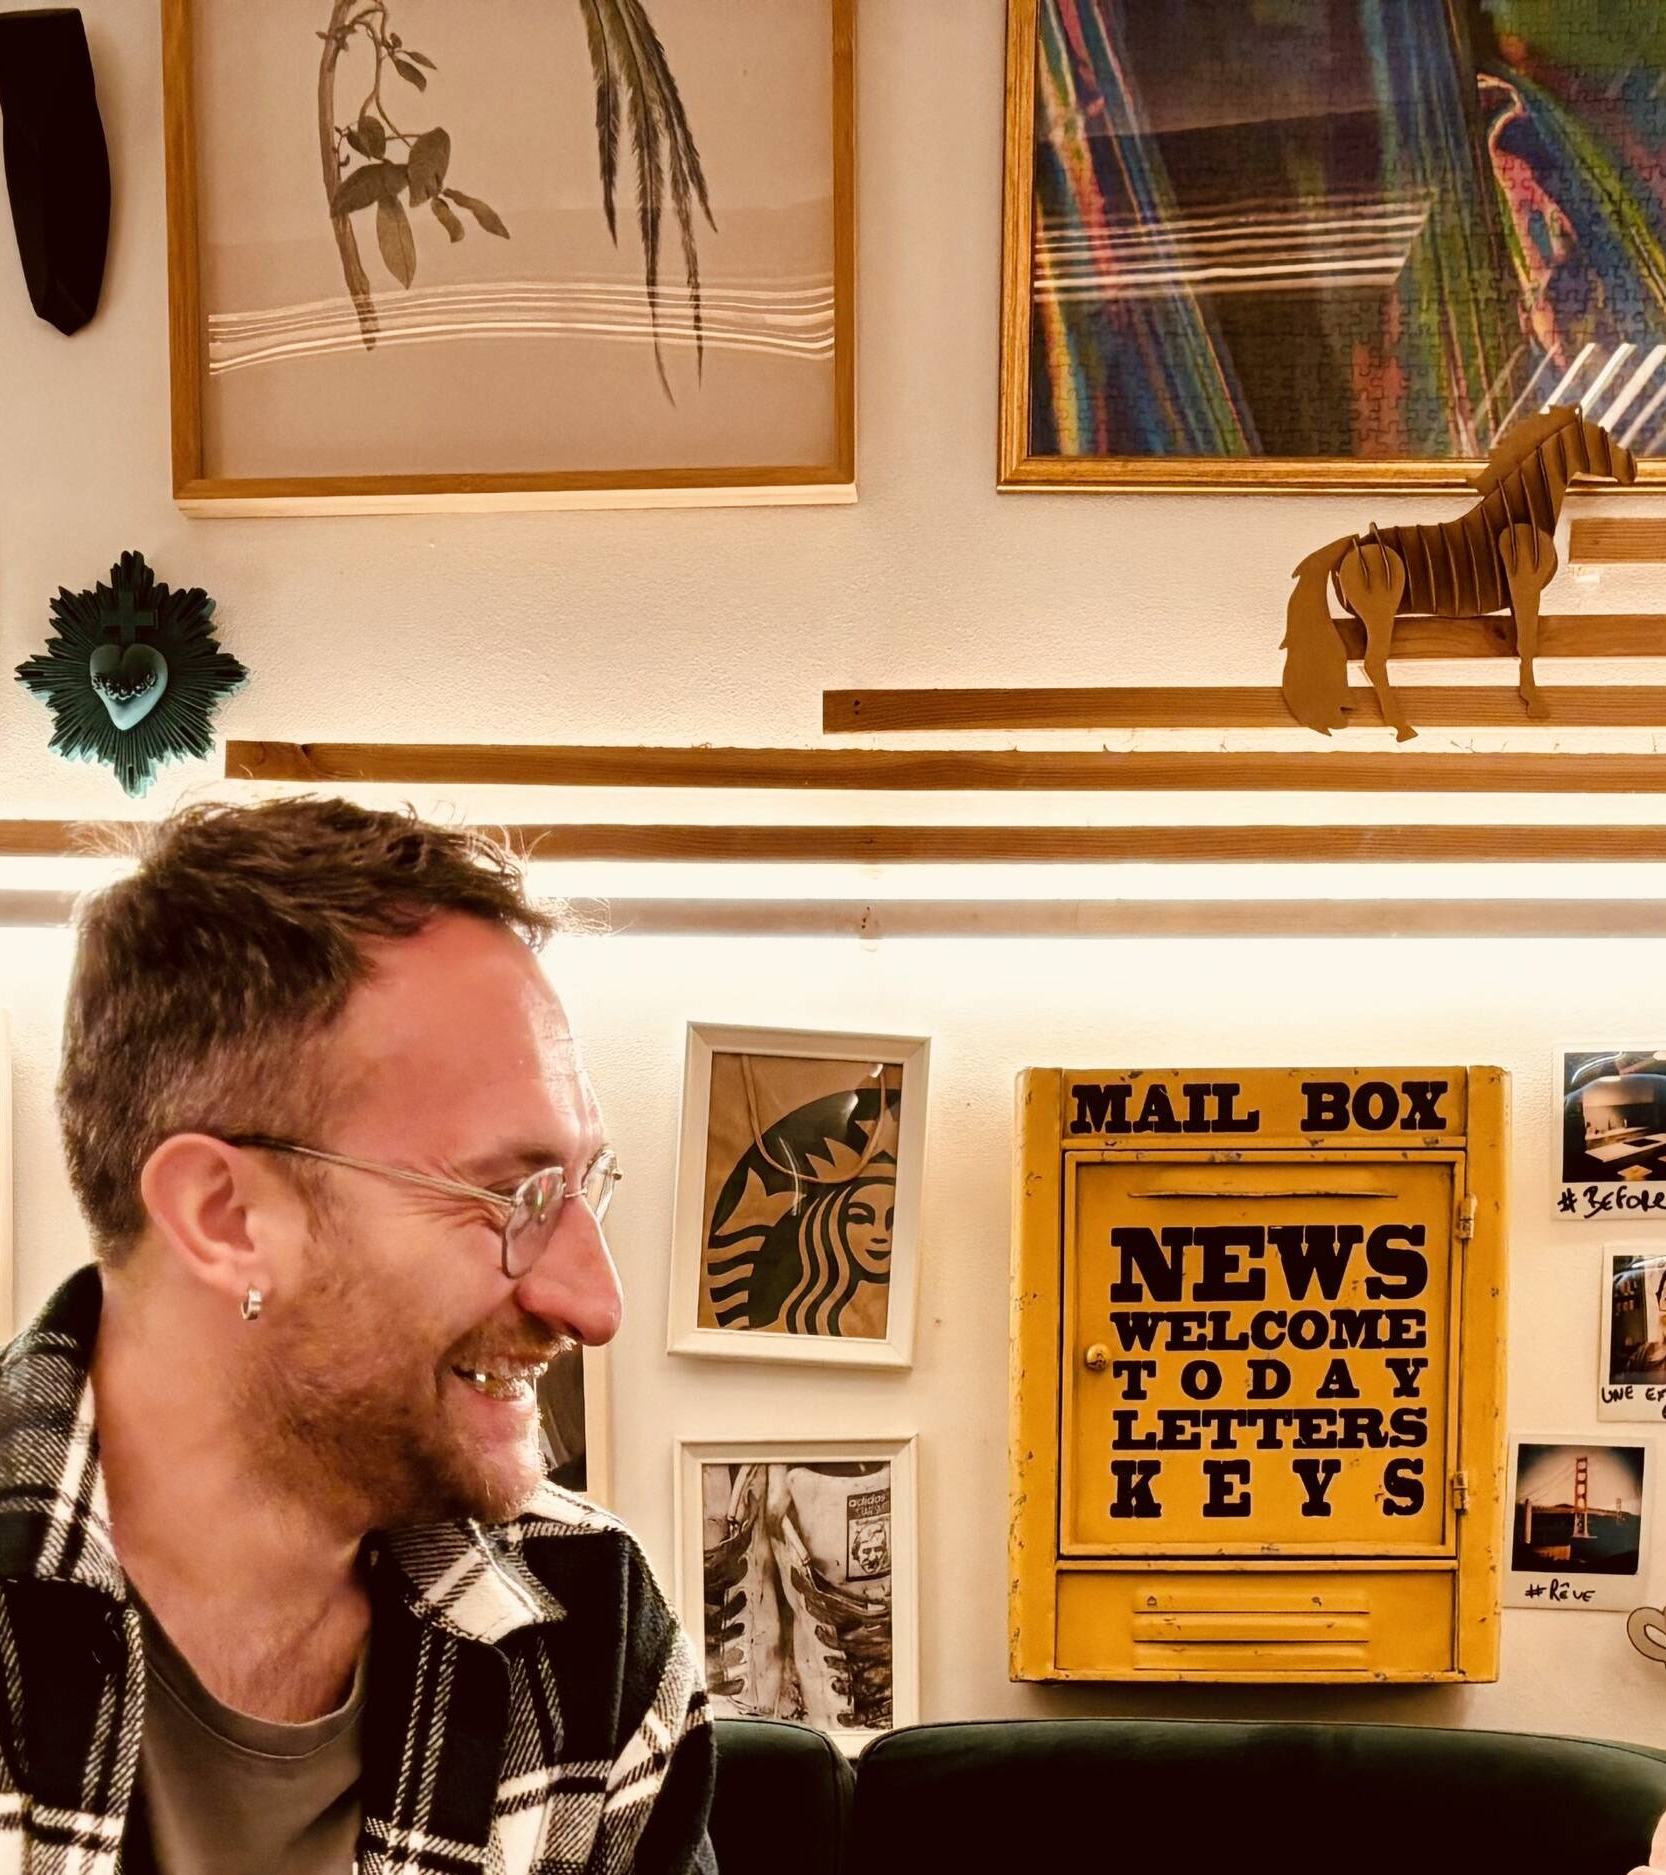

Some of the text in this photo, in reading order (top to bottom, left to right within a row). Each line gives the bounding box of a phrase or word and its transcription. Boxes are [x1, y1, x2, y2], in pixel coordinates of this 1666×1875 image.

[1070, 1081, 1450, 1135] MAIL BOX
[1109, 1223, 1430, 1303] NEWS
[1109, 1307, 1428, 1353] WELCOME
[1112, 1356, 1429, 1401] TODAY
[1601, 1386, 1634, 1404] UNE
[1111, 1405, 1429, 1452] LETTERS
[1109, 1456, 1427, 1519] KEYS
